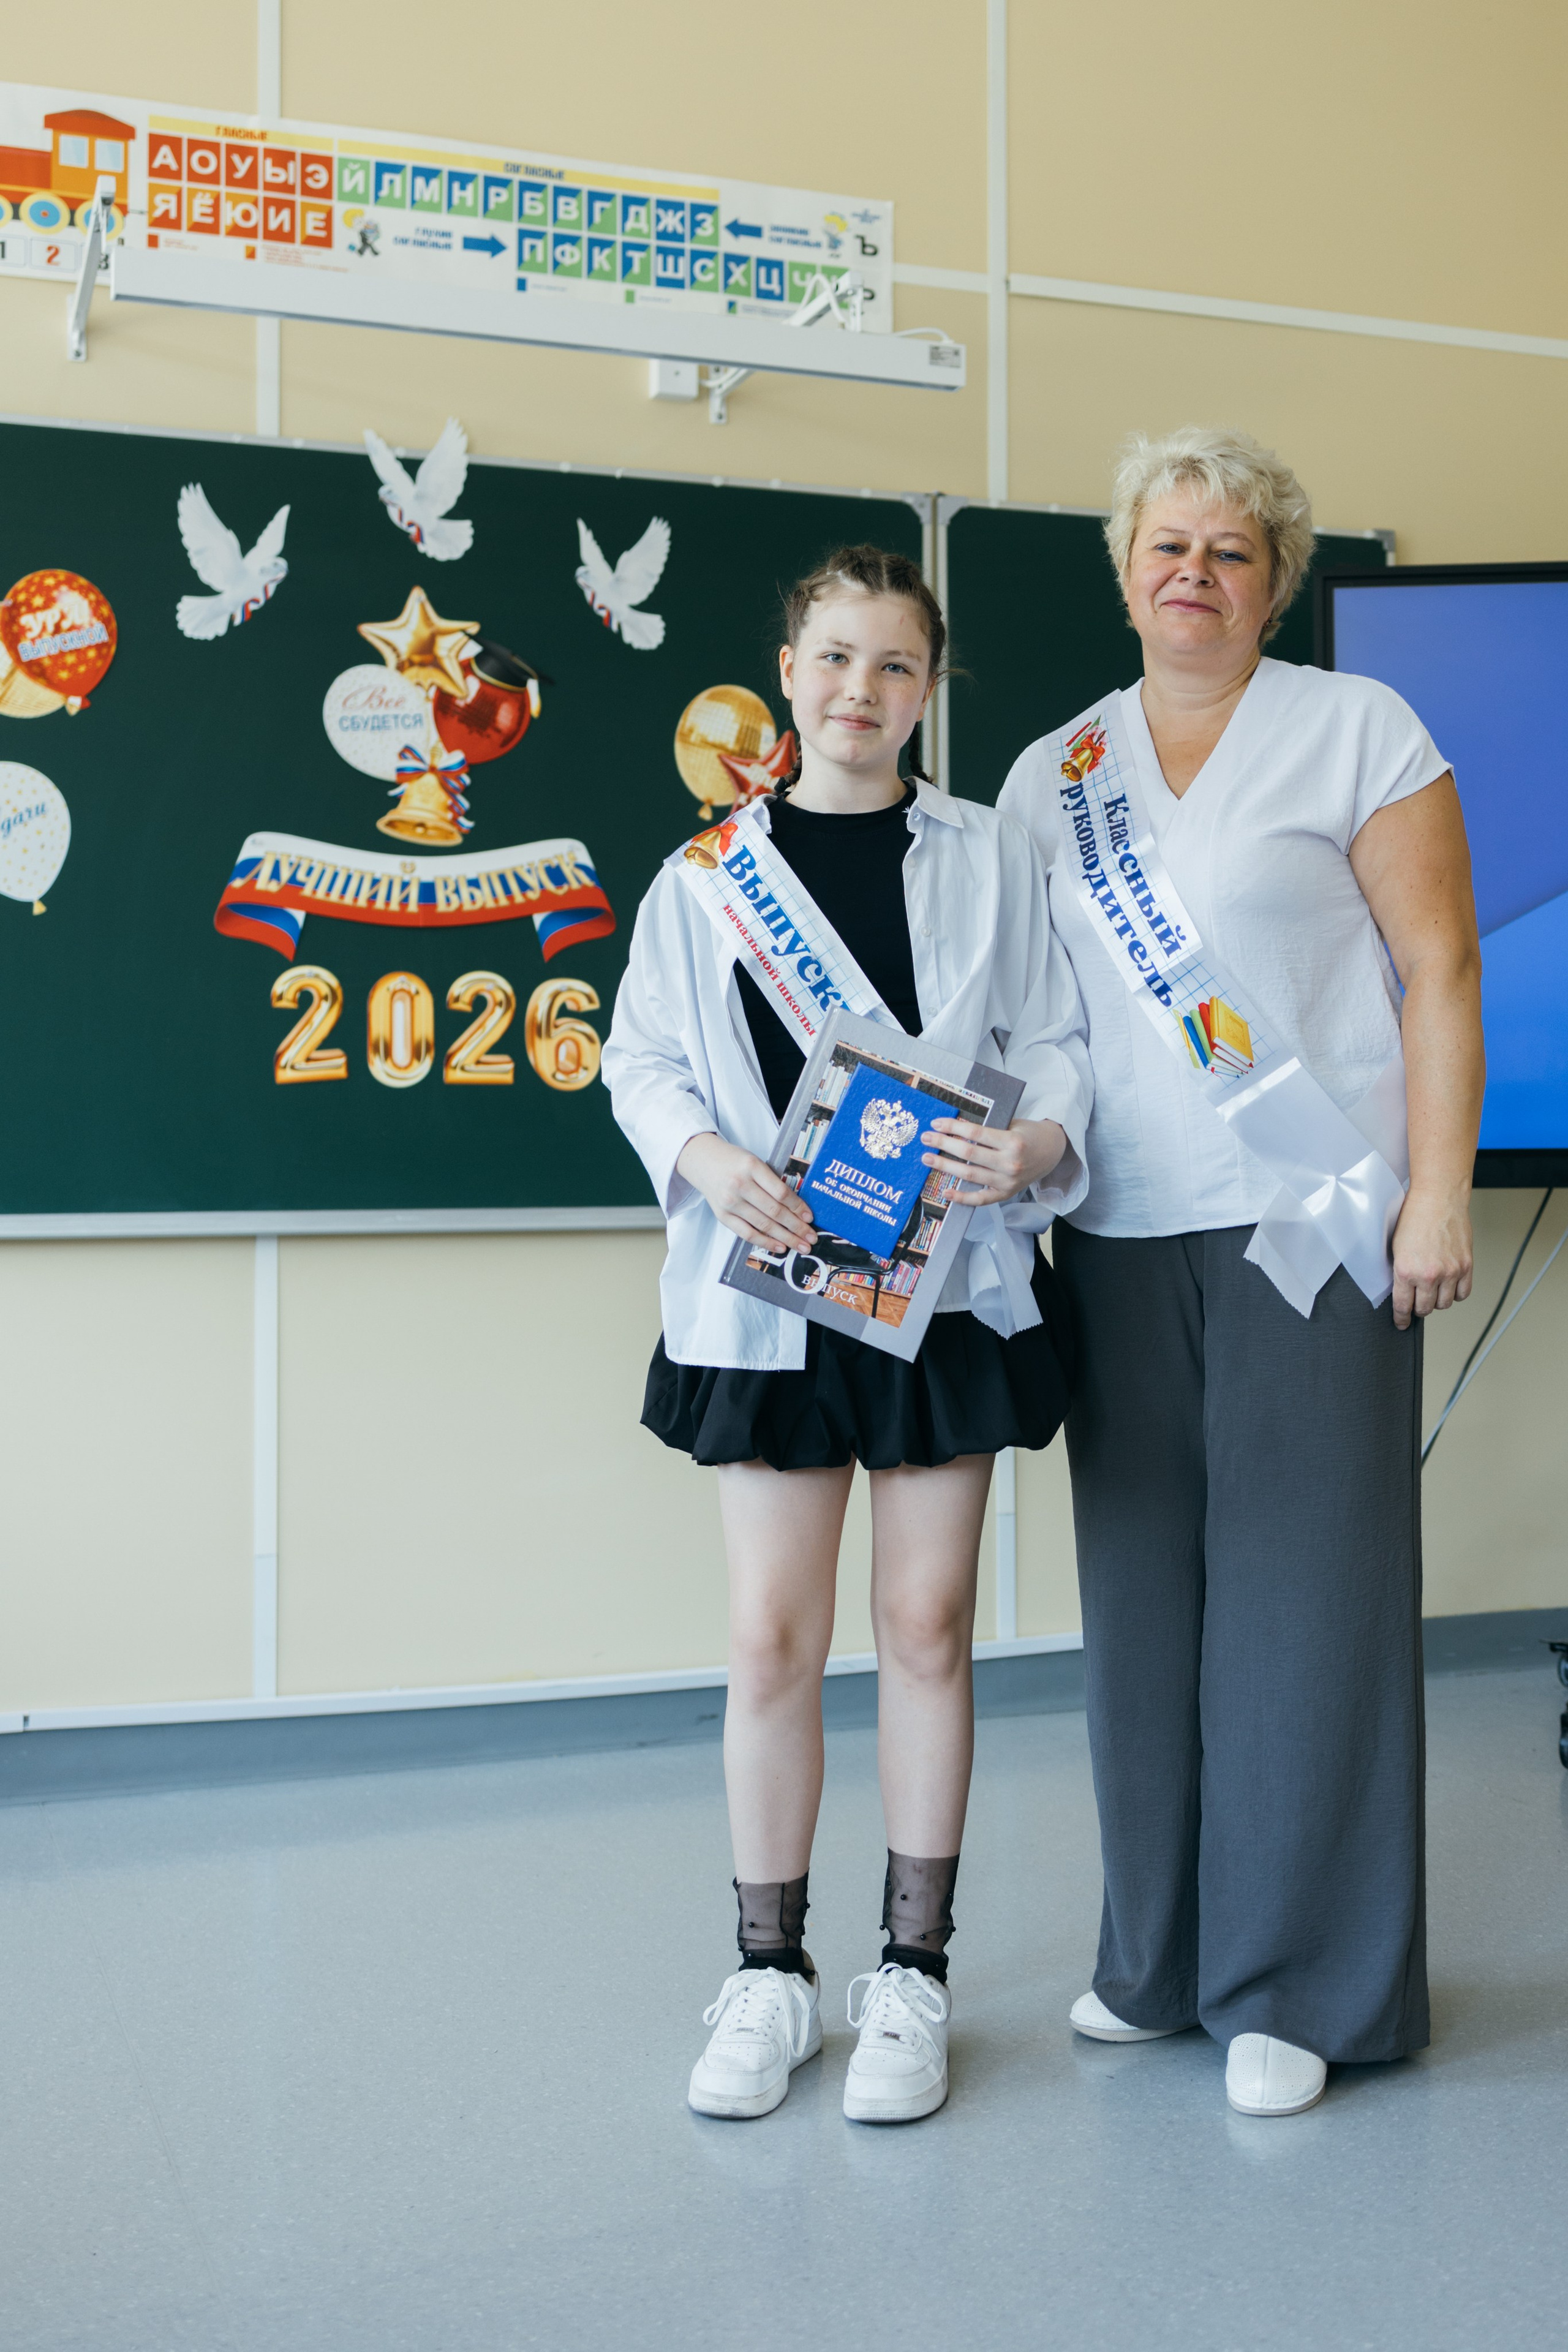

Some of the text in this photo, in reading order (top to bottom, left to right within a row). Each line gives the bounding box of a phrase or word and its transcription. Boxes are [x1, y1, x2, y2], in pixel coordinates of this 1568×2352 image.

[152, 144, 329, 189] А О У Ы Э
[153, 192, 327, 237] Я Ё Ю И Е
[342, 162, 715, 236] Й Л М Н Р Б В Г Д Ж З
[46, 246, 59, 265] 2
[522, 237, 545, 263] П
[554, 243, 581, 266] Ф
[592, 246, 611, 271] К
[626, 250, 647, 274] Т
[656, 254, 684, 279] Ш
[693, 257, 715, 282] С
[727, 262, 748, 287] Х
[758, 266, 781, 295] Ц
[18, 622, 109, 662] ВЫПУСКНОЙ
[338, 713, 424, 732] СБУДЕТСЯ
[230, 850, 595, 913] ЛУЧШИЙ ВЫПУСК
[1060, 782, 1174, 1008] руководитель
[1104, 793, 1186, 959] Классный
[722, 844, 851, 1012] Выпуск
[723, 904, 816, 1037] начальной школы
[270, 965, 601, 1091] 2026
[811, 1180, 897, 1227] НАЧАЛЬНОЙ ШКОЛЫ
[824, 1159, 903, 1204] ДИПЛОМ
[825, 1177, 892, 1213] ОБ ОКОНЧАНИИ
